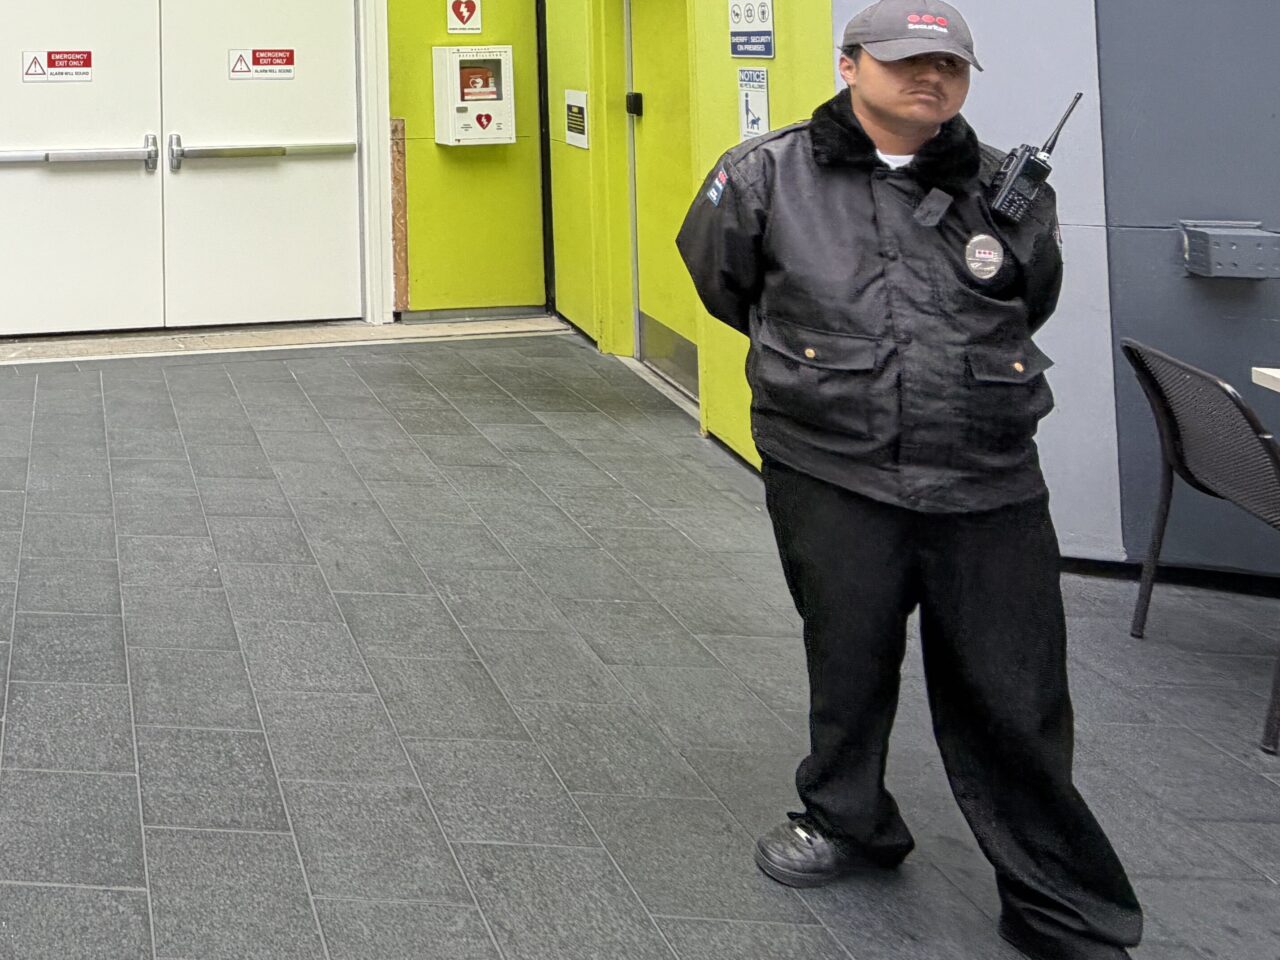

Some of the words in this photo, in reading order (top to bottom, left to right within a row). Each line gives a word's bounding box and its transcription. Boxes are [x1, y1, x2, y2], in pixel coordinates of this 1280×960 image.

[908, 23, 949, 33] Securitas
[750, 35, 771, 43] SECURITY
[739, 70, 765, 82] NOTICE
